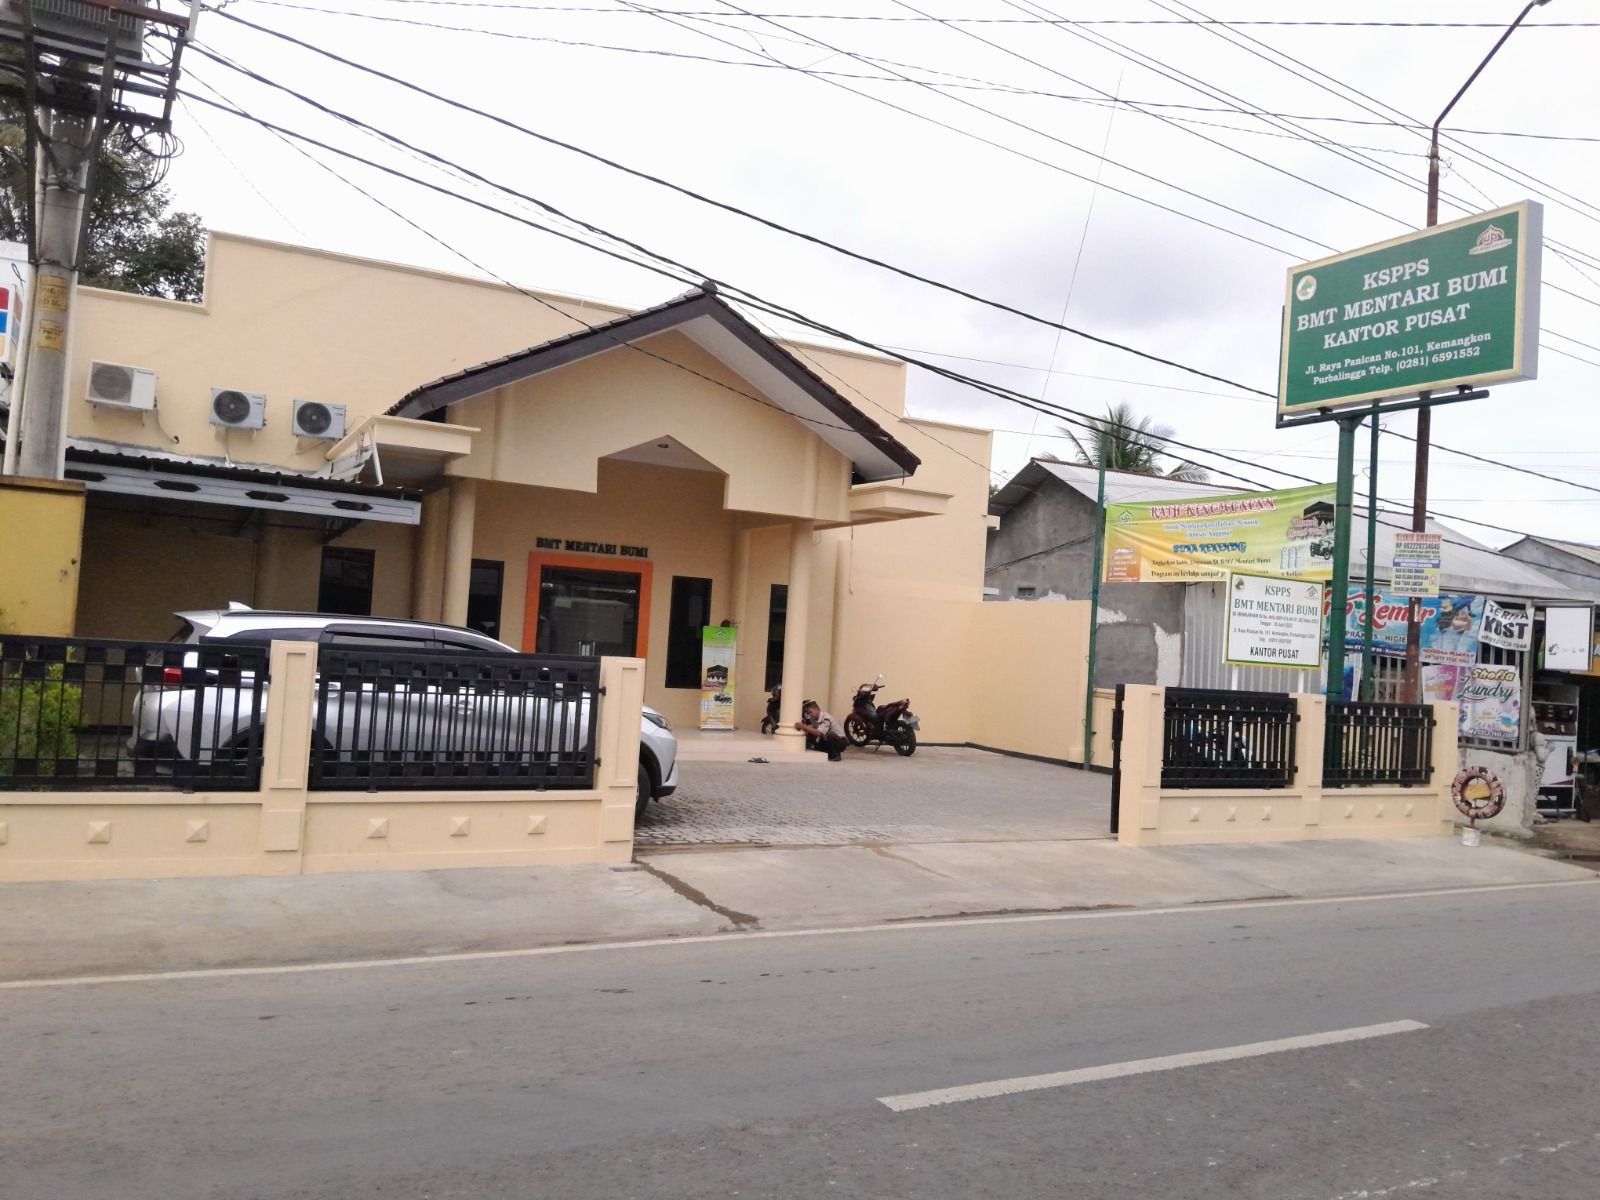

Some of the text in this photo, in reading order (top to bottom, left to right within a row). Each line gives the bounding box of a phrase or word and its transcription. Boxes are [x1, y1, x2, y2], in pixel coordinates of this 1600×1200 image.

[1363, 258, 1430, 291] KSPPS
[1297, 265, 1508, 331] BMT MENTARI BUMI
[1323, 303, 1470, 349] KANTOR PUSAT
[1305, 364, 1317, 375] Jl.
[1319, 360, 1342, 374] Raya
[1344, 353, 1382, 368] Panican
[1426, 332, 1491, 354] Kemangkon
[1313, 346, 1480, 385] Purbalingga Telp. (0281) 6591552
[536, 537, 648, 557] BMT MENTARI BUMI
[1265, 585, 1291, 597] KSPPS
[1234, 598, 1318, 616] BMT MENTARI BUMI
[1484, 616, 1528, 639] KOST
[1250, 646, 1299, 659] KANTOR PUSAT
